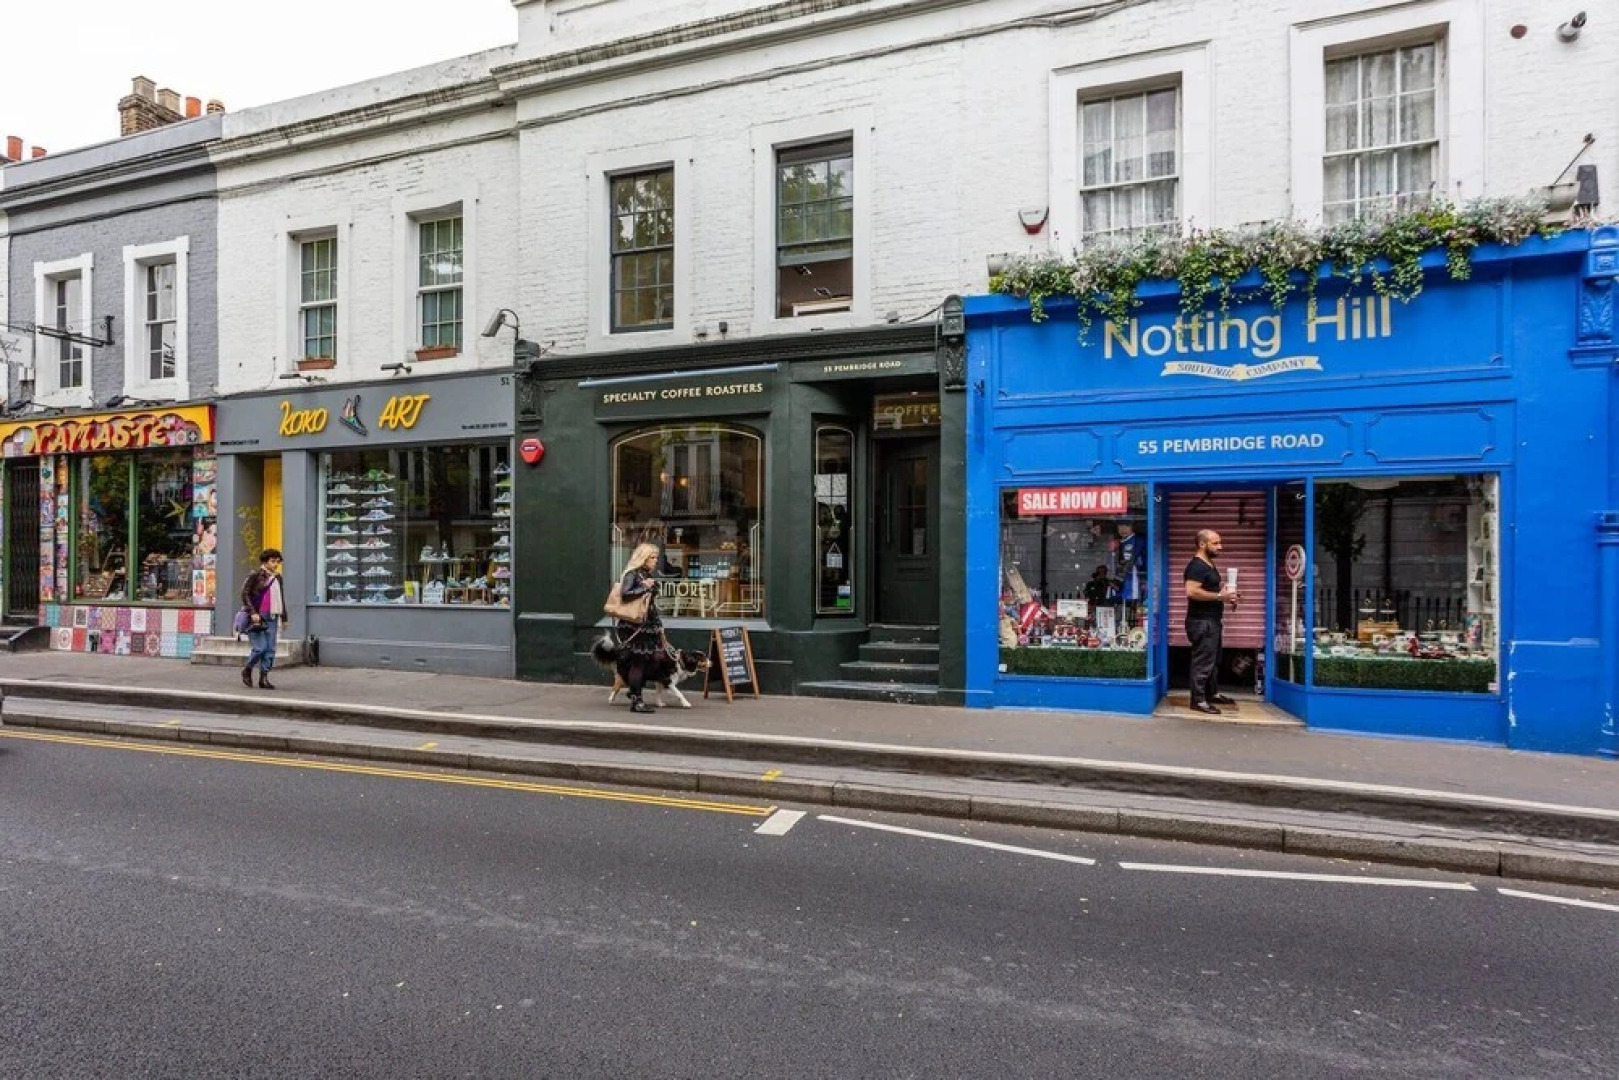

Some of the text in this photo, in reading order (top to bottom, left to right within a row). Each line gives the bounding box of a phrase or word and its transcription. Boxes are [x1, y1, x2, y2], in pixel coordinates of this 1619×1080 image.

[1103, 295, 1391, 358] Notting Hill
[834, 362, 877, 372] PEMBRIDGE
[878, 360, 902, 369] ROAD
[1177, 359, 1306, 378] SOUVENIR COMPANY
[603, 382, 764, 404] SPECIALTY COFFEE ROASTERS
[378, 393, 431, 430] ART
[22, 415, 176, 454] NAMASTE
[1138, 433, 1325, 454] 55 PEMBRIDGE ROAD
[1022, 490, 1123, 511] SALE NOW ON
